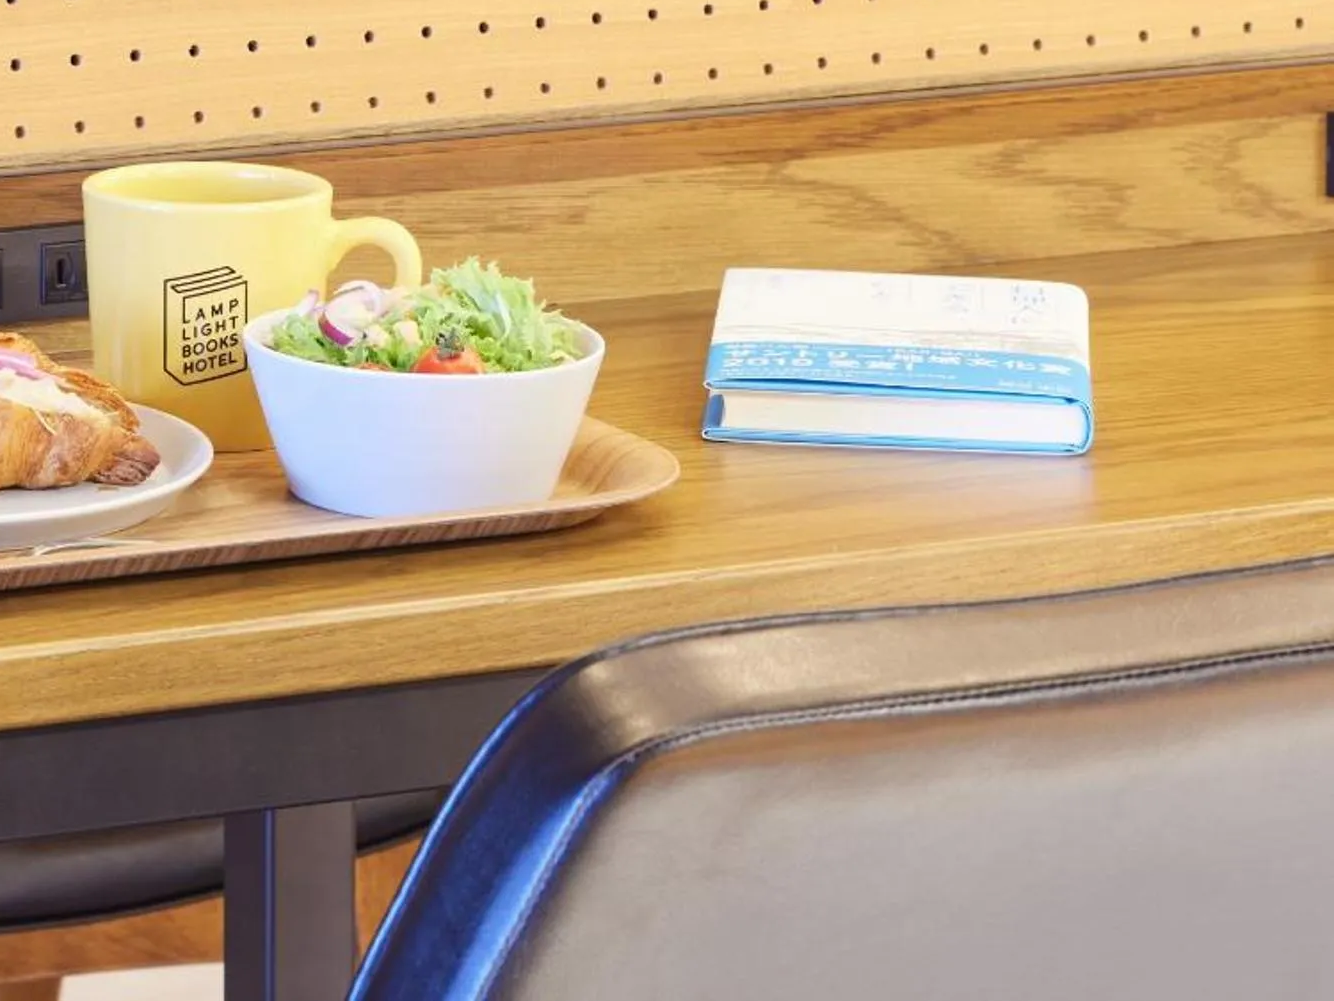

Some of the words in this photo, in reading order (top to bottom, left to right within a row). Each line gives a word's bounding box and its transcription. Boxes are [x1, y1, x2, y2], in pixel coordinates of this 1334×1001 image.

[183, 298, 239, 324] LAMP
[182, 316, 239, 341] LIGHT
[182, 333, 239, 358] BOOKS
[183, 351, 237, 375] HOTEL
